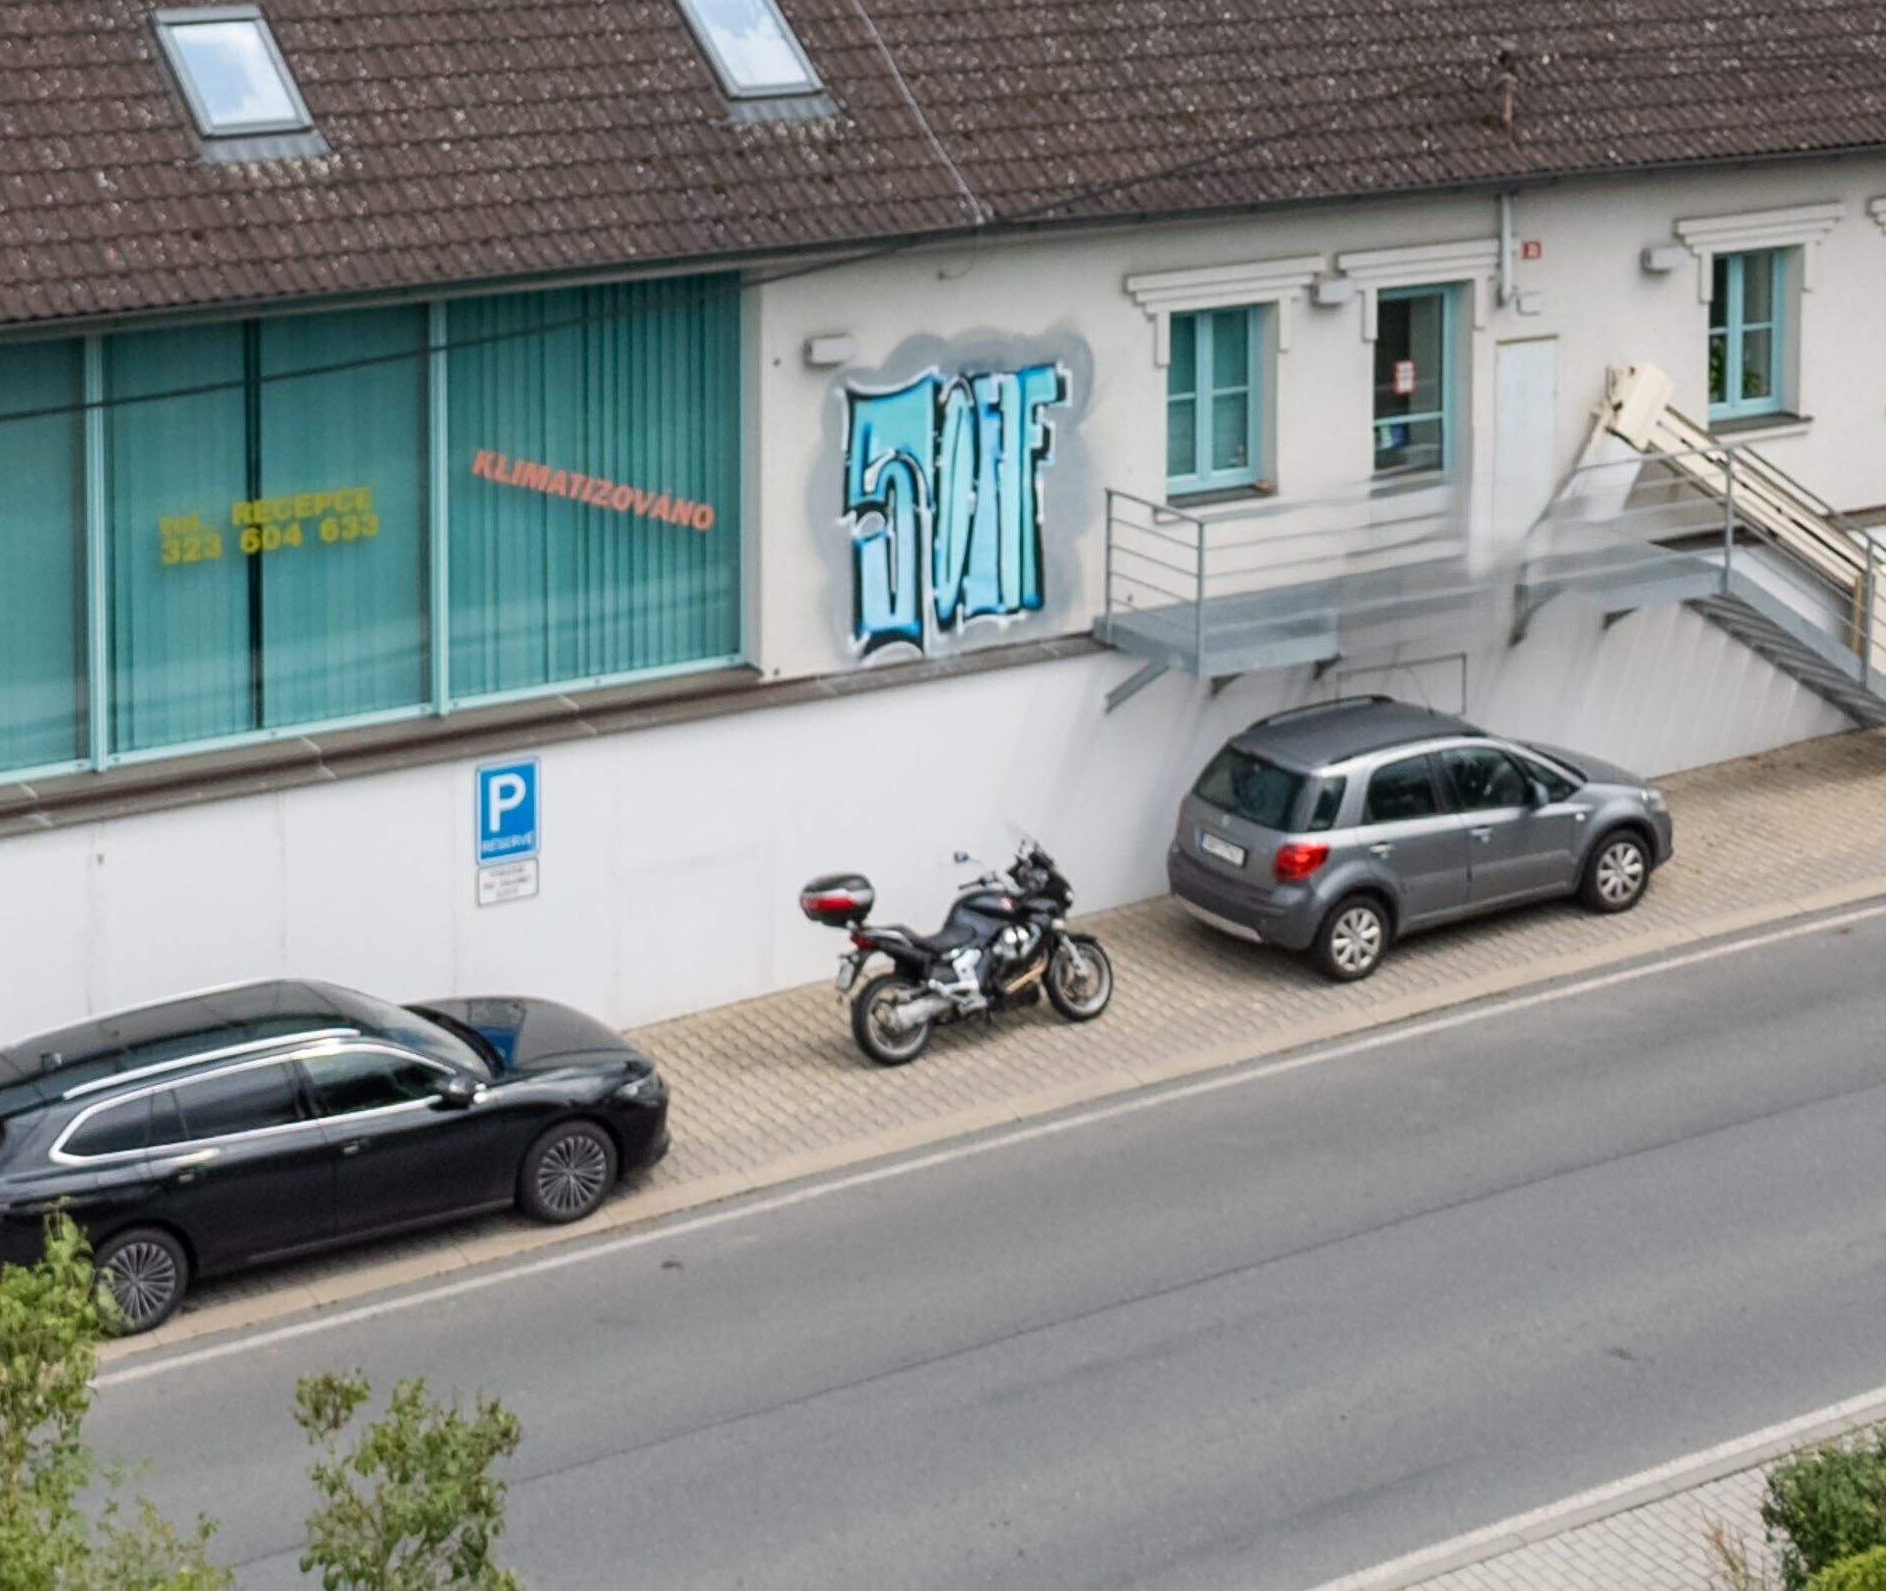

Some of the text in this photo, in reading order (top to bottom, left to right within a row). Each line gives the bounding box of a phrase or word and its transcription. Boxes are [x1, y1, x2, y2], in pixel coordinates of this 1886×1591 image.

[231, 486, 372, 526] RECEPCE
[472, 449, 714, 531] KLIMATIZOVÁNO
[162, 512, 379, 564] 323 604 633
[489, 773, 527, 833] P
